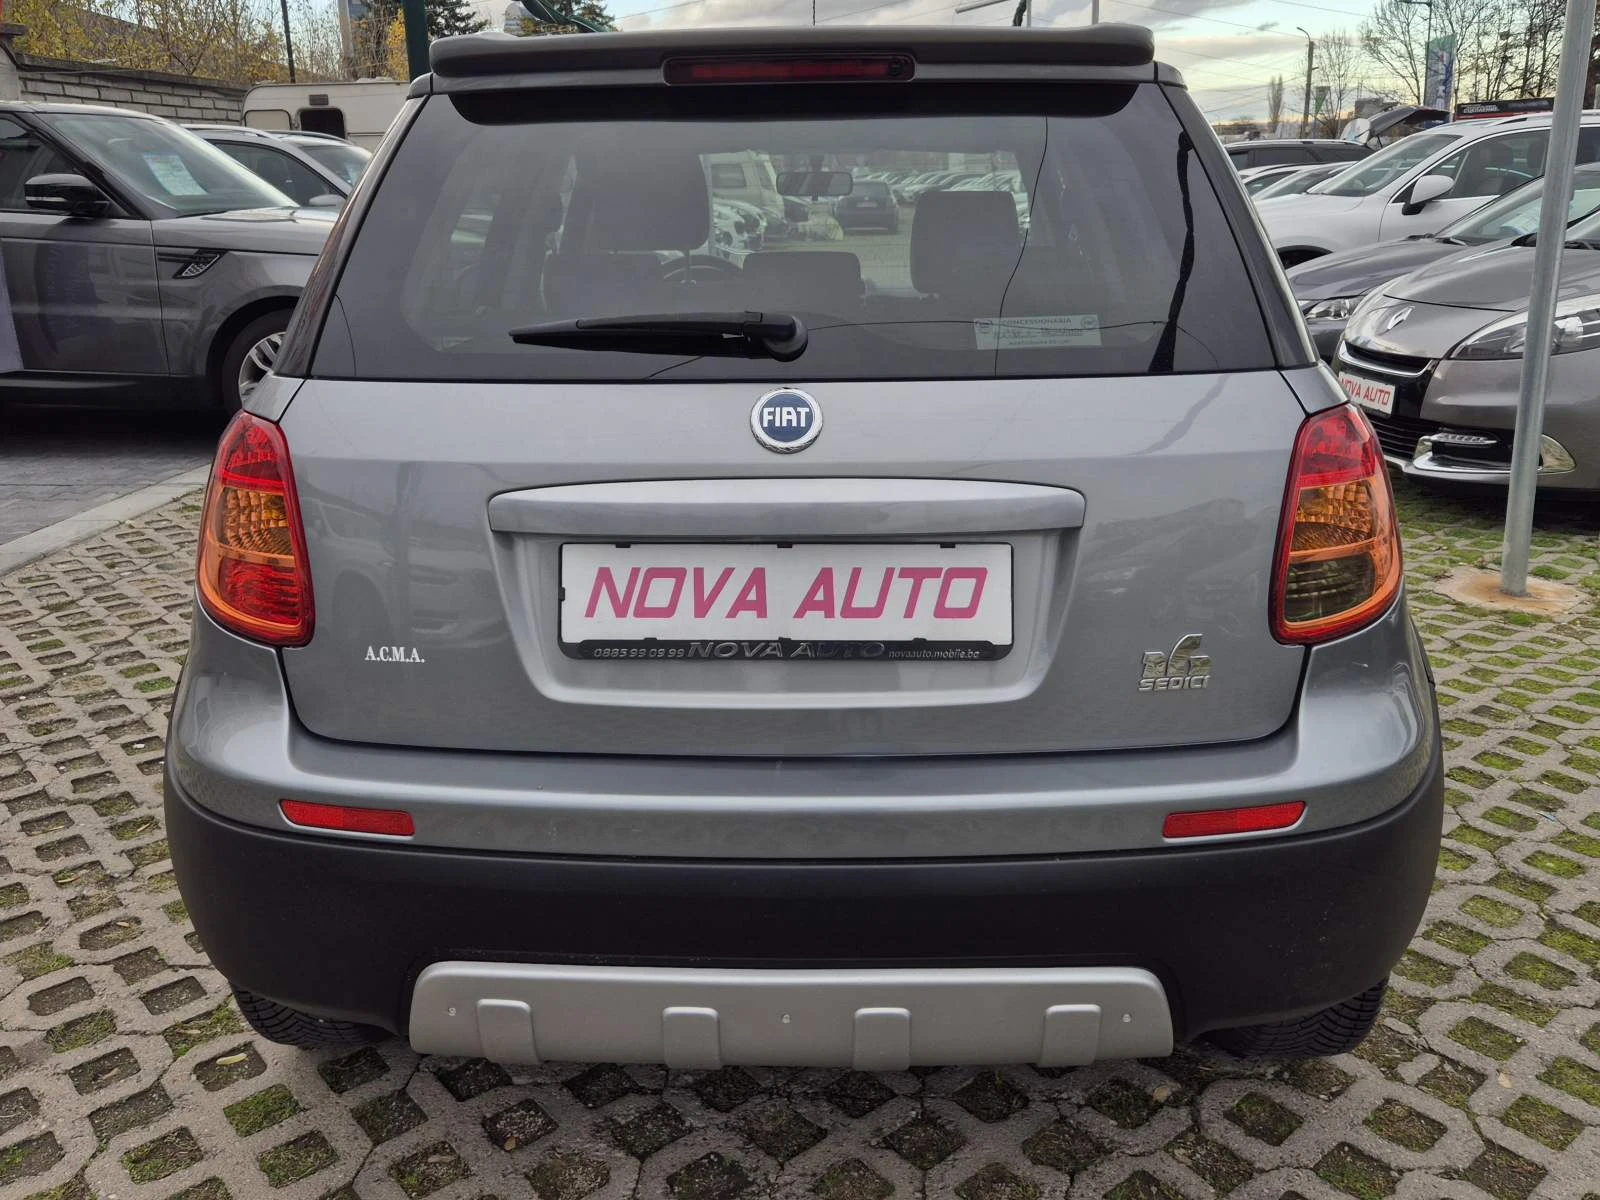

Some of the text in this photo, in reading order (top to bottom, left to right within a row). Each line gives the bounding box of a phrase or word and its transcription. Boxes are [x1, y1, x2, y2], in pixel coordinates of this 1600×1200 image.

[1363, 386, 1391, 406] AUTO
[763, 406, 810, 427] FIAT
[584, 567, 988, 619] NOVA AUTO
[364, 645, 425, 663] A.C.M.A.
[593, 648, 628, 658] 0885
[629, 649, 647, 658] 99
[650, 648, 665, 658] 09
[667, 648, 685, 658] 99
[687, 642, 783, 658] NOVA
[790, 642, 885, 658] AUTO
[1138, 675, 1211, 692] SEDICI
